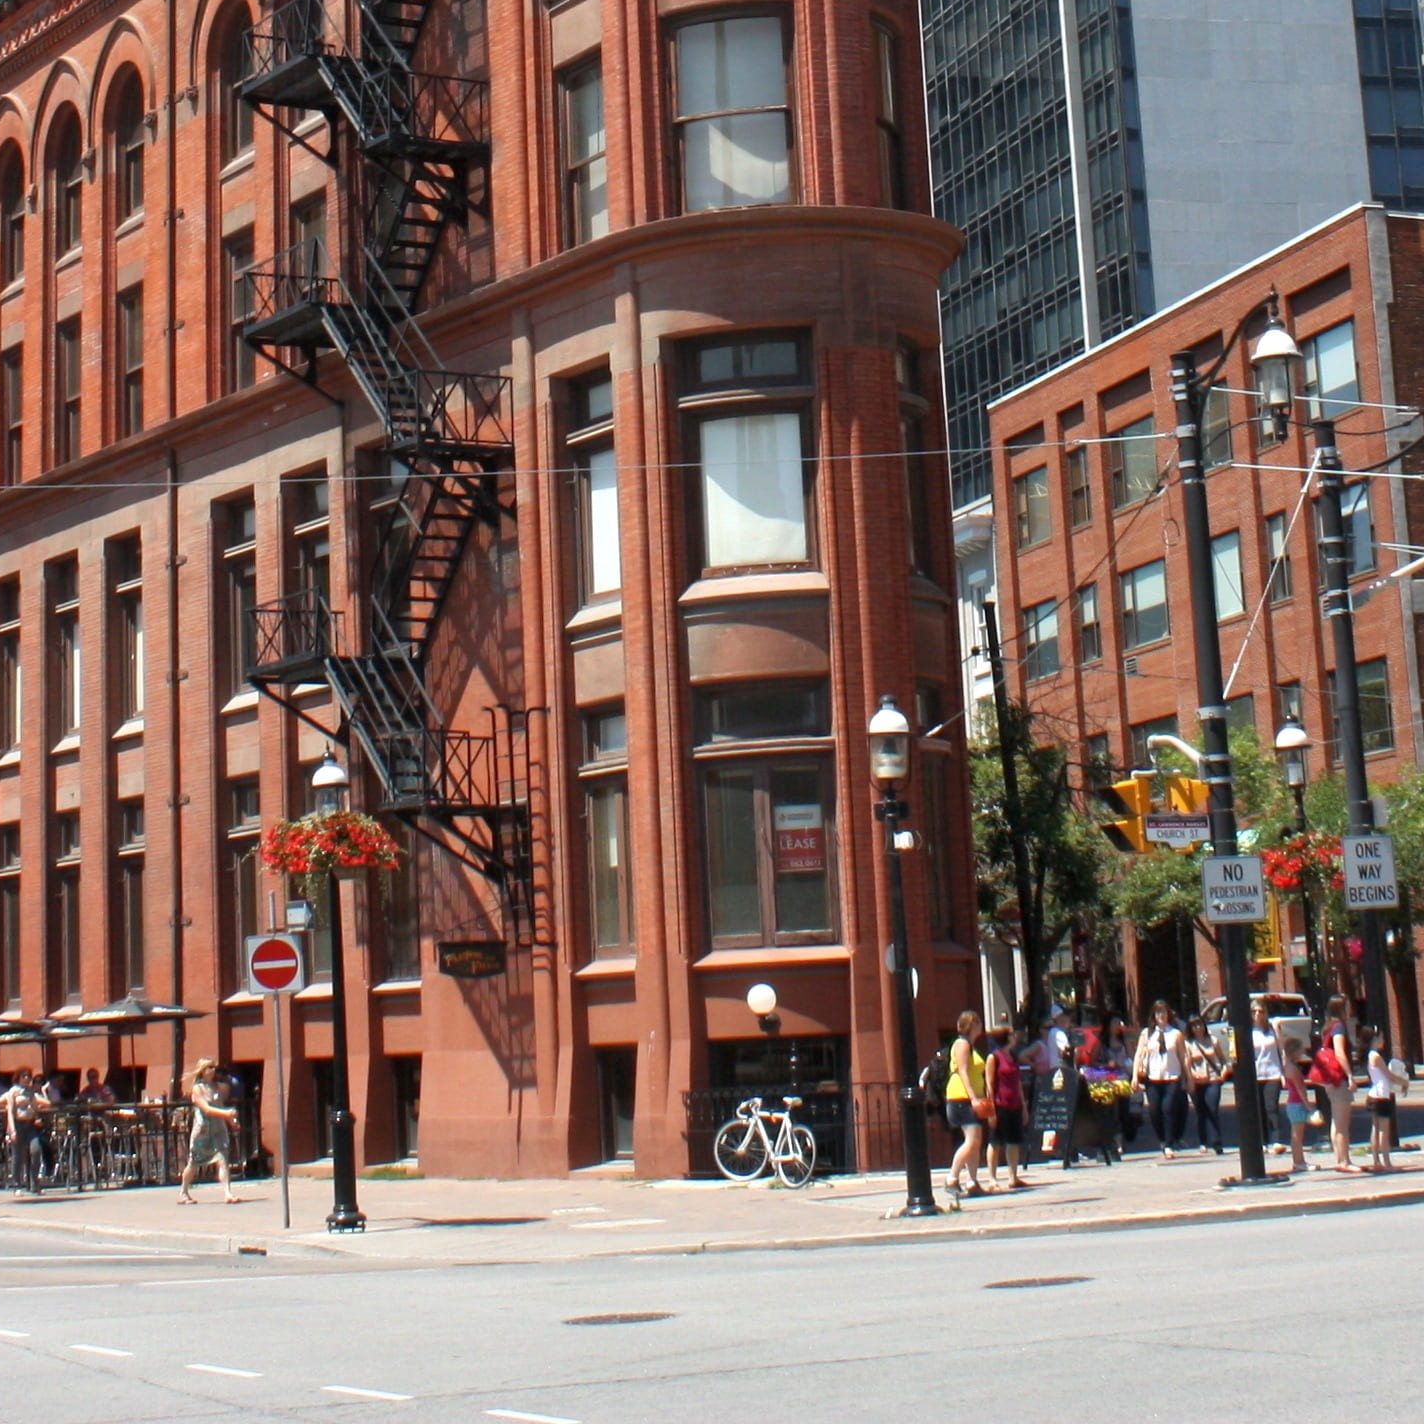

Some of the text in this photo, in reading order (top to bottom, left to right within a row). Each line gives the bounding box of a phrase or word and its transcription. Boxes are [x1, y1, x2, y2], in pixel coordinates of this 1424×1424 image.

[779, 839, 817, 851] LEASE
[1355, 842, 1381, 858] ONE
[1223, 864, 1243, 881] NO
[1357, 864, 1381, 880] WAY
[1209, 886, 1259, 898] PEDESTRIAN
[1349, 885, 1396, 903] BEGINS
[1215, 902, 1256, 914] ROSSING
